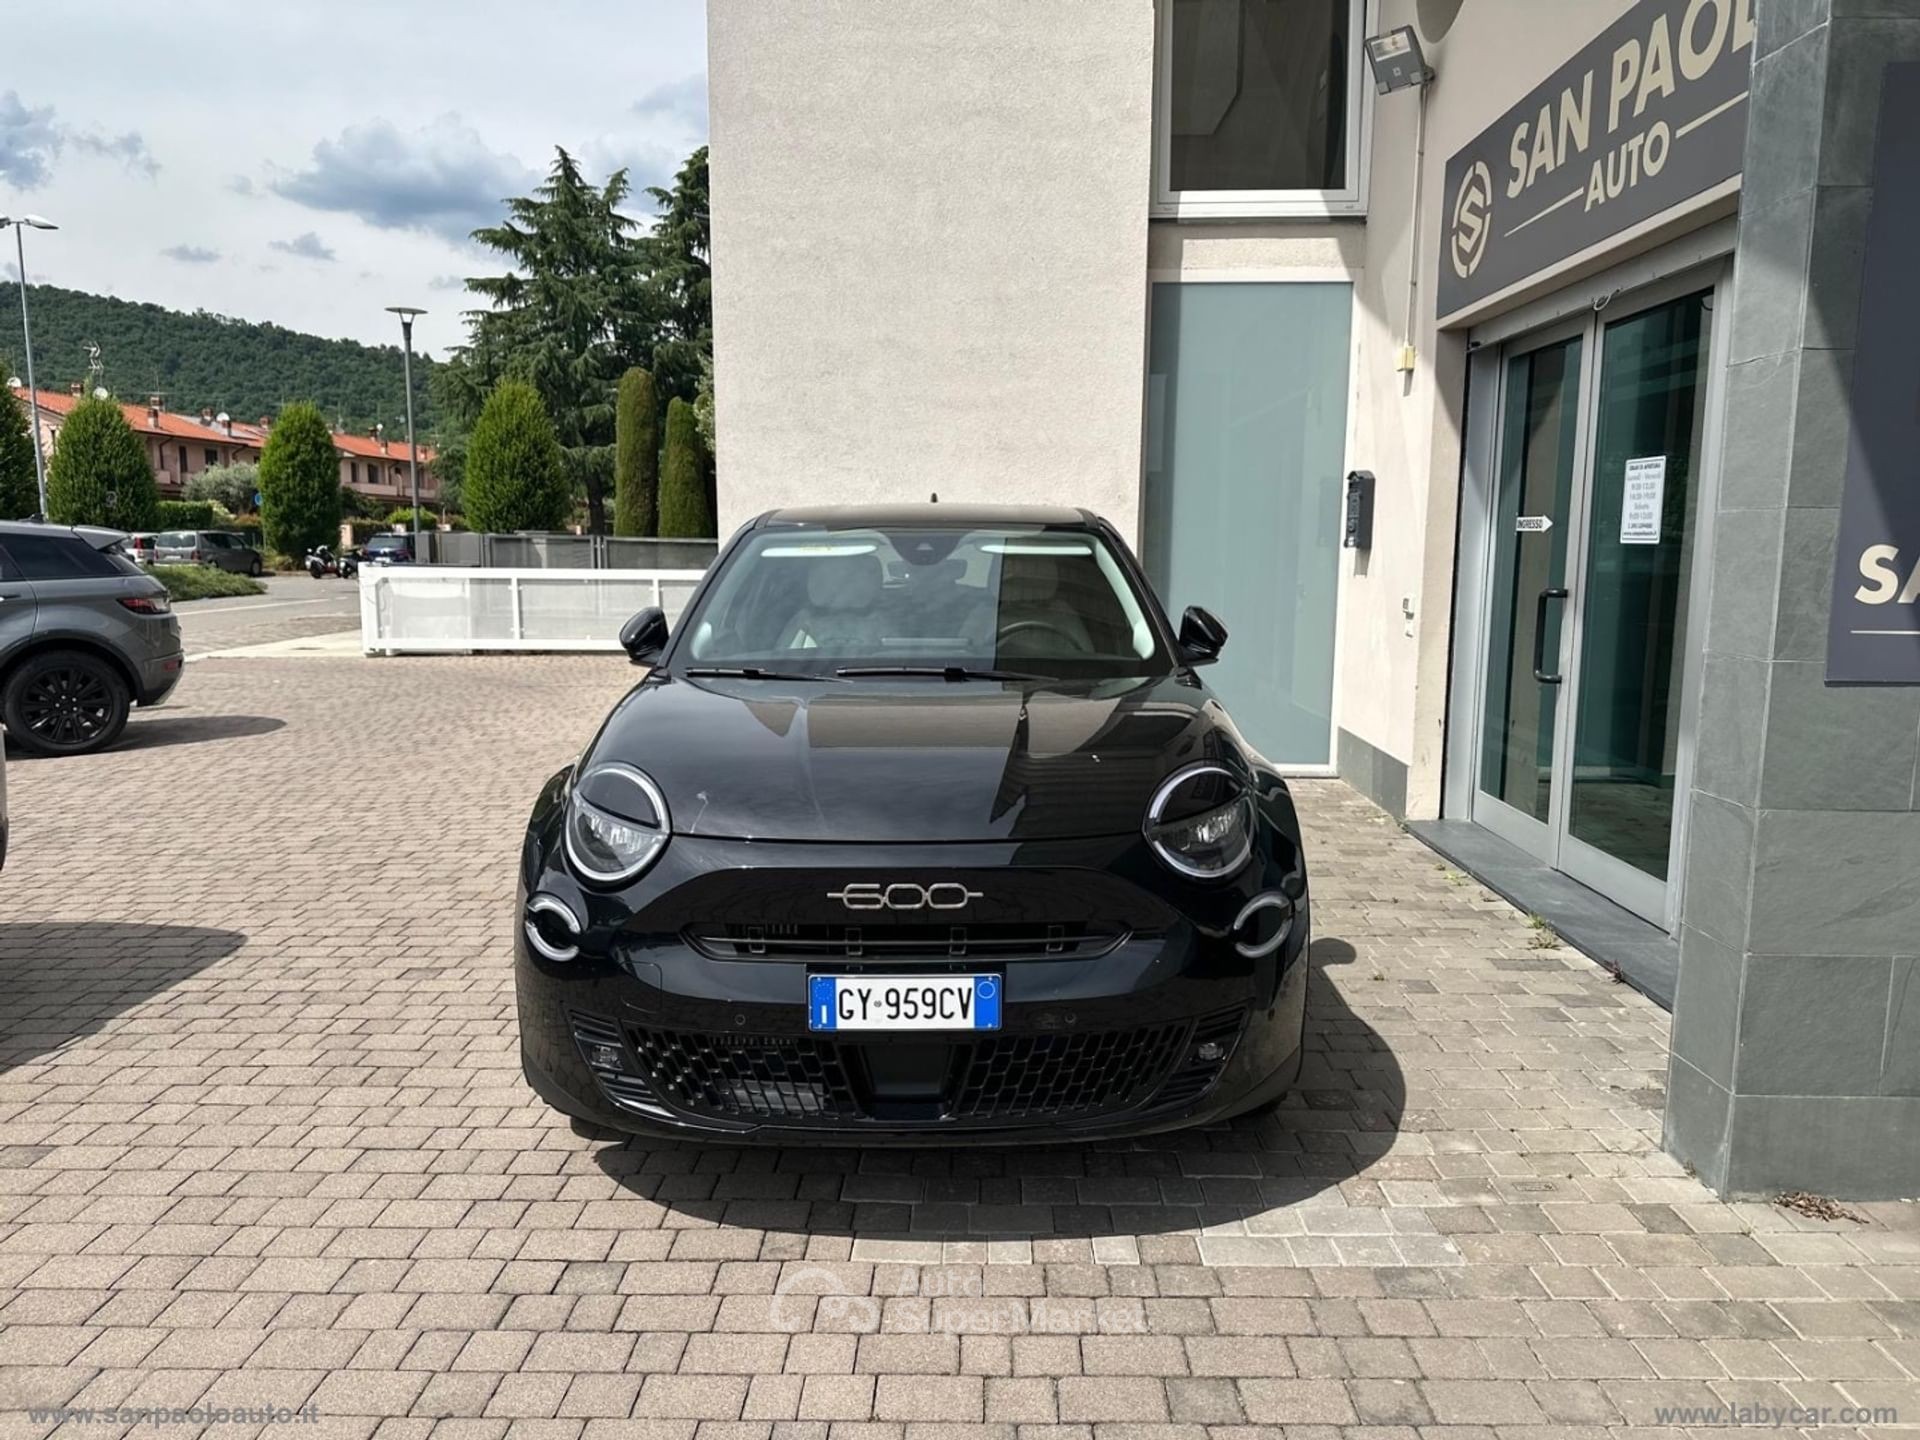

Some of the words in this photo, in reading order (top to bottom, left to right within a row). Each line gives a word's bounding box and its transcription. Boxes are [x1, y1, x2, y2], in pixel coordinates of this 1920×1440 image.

[1506, 70, 1593, 199] SAN
[1584, 120, 1670, 213] AUTO
[1517, 518, 1543, 529] INGRESSO
[842, 883, 970, 909] 600
